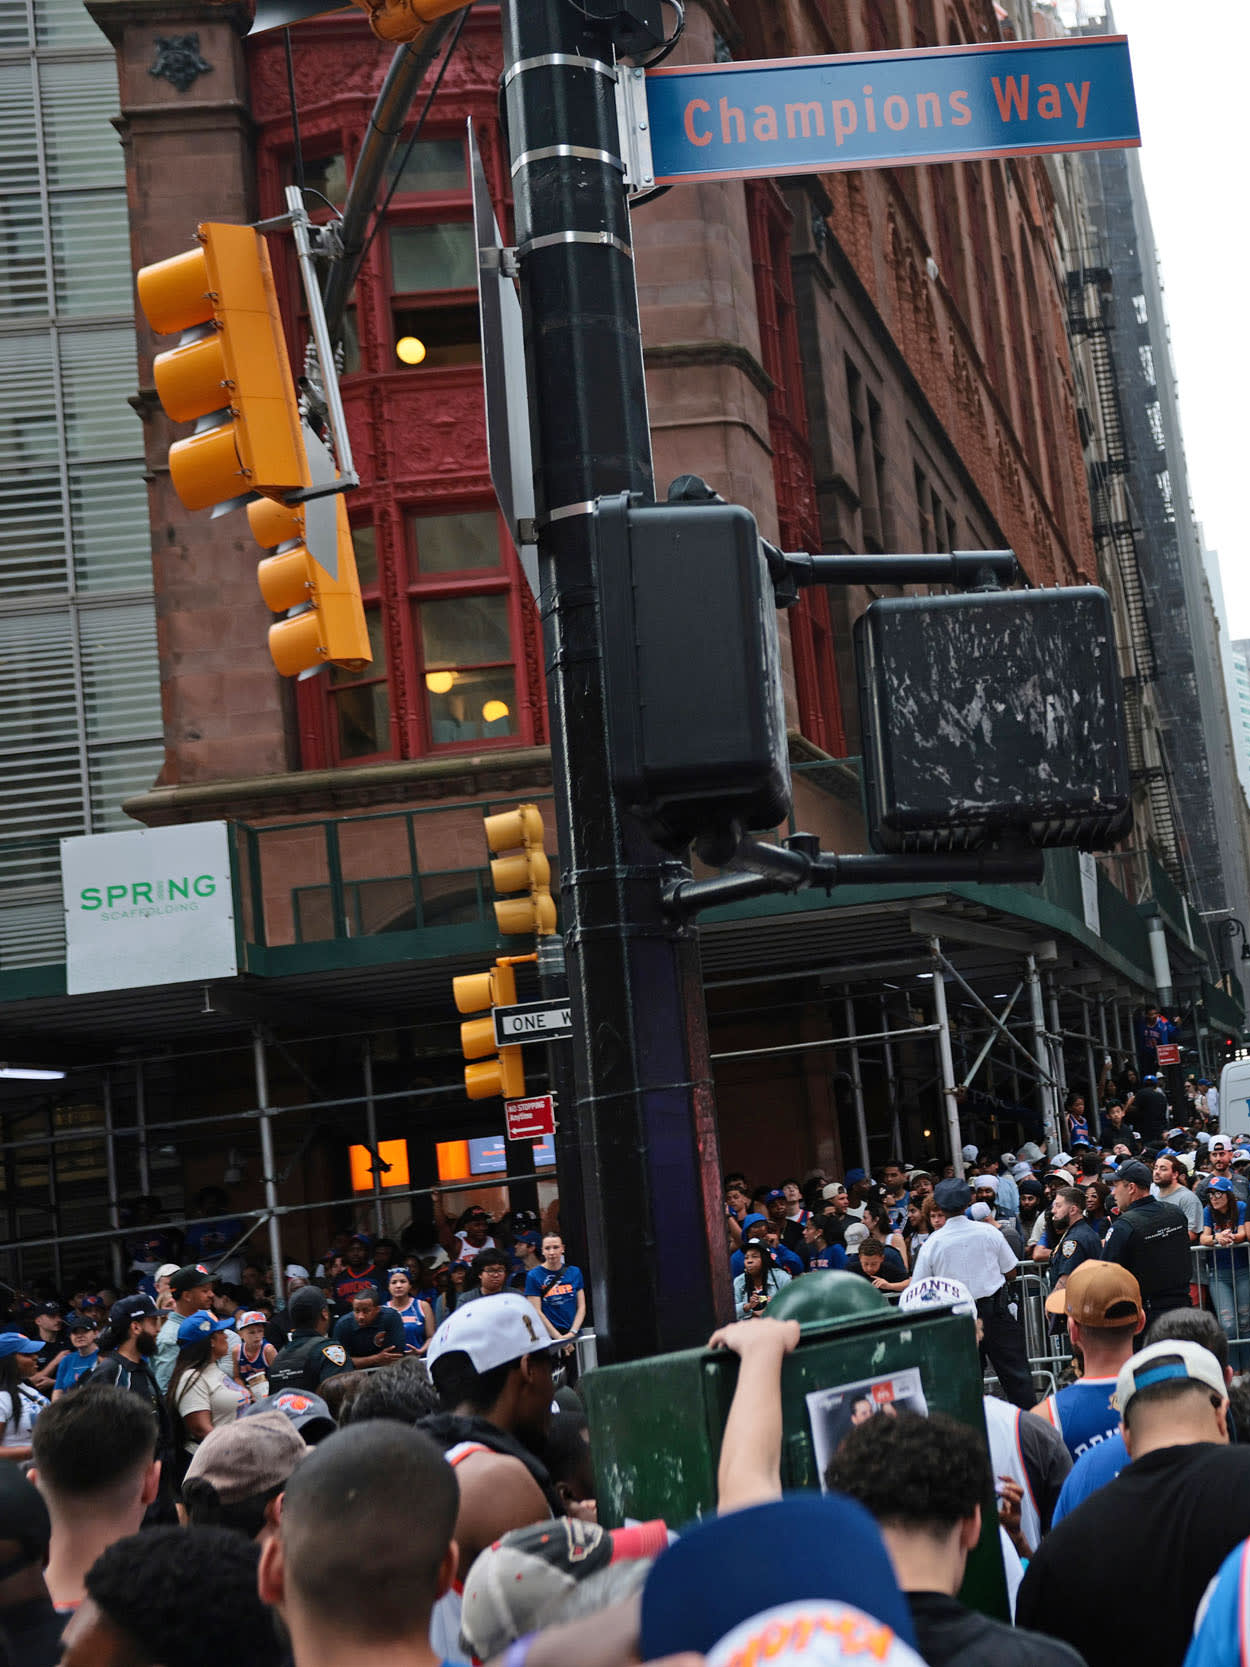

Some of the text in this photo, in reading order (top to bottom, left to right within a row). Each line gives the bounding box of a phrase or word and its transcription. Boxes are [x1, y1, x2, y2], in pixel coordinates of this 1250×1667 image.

[683, 74, 1092, 147] Champions Way
[80, 874, 217, 911] SPRING
[101, 901, 201, 922] SCAFFOLDING
[512, 1013, 547, 1032] ONE
